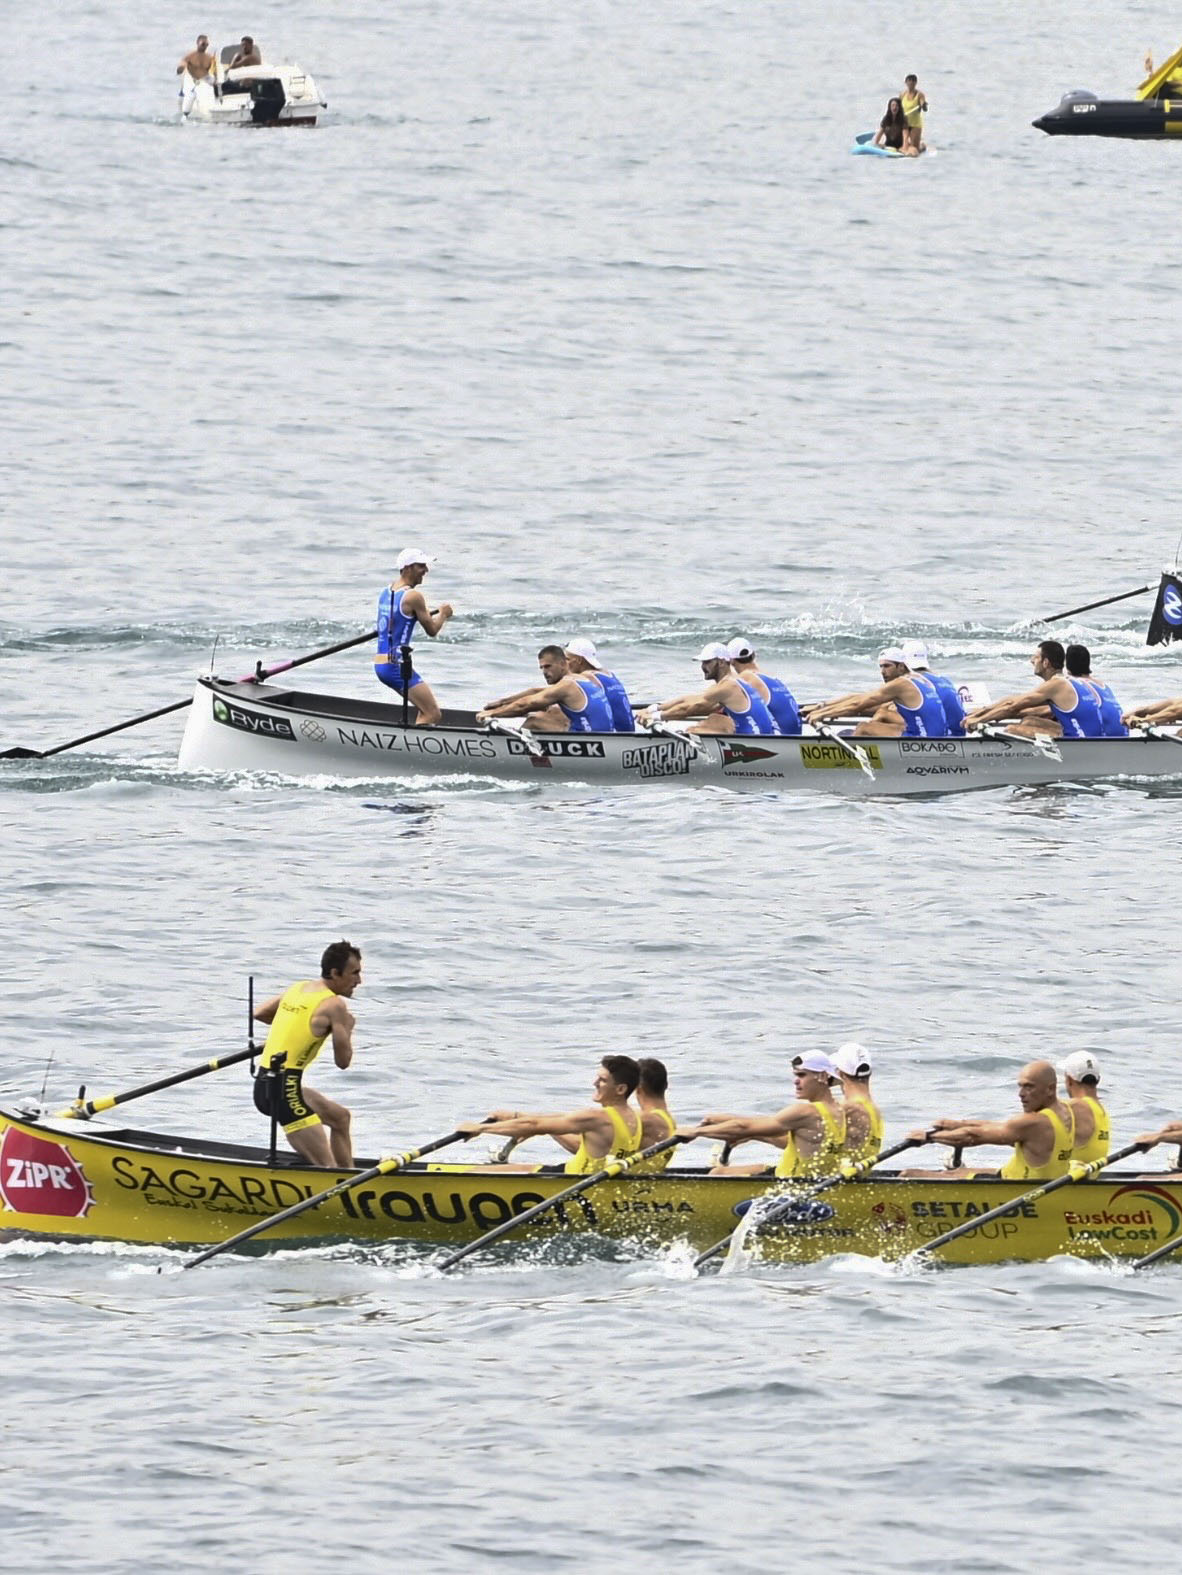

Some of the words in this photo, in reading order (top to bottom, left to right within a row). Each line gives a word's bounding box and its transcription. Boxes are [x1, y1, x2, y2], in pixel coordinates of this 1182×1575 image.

[229, 709, 292, 735] Ryde
[623, 741, 698, 768] BATAPLAN
[285, 1074, 307, 1117] ORIALKI
[1063, 1210, 1154, 1225] Euskadi
[1068, 1225, 1158, 1242] LowCost
